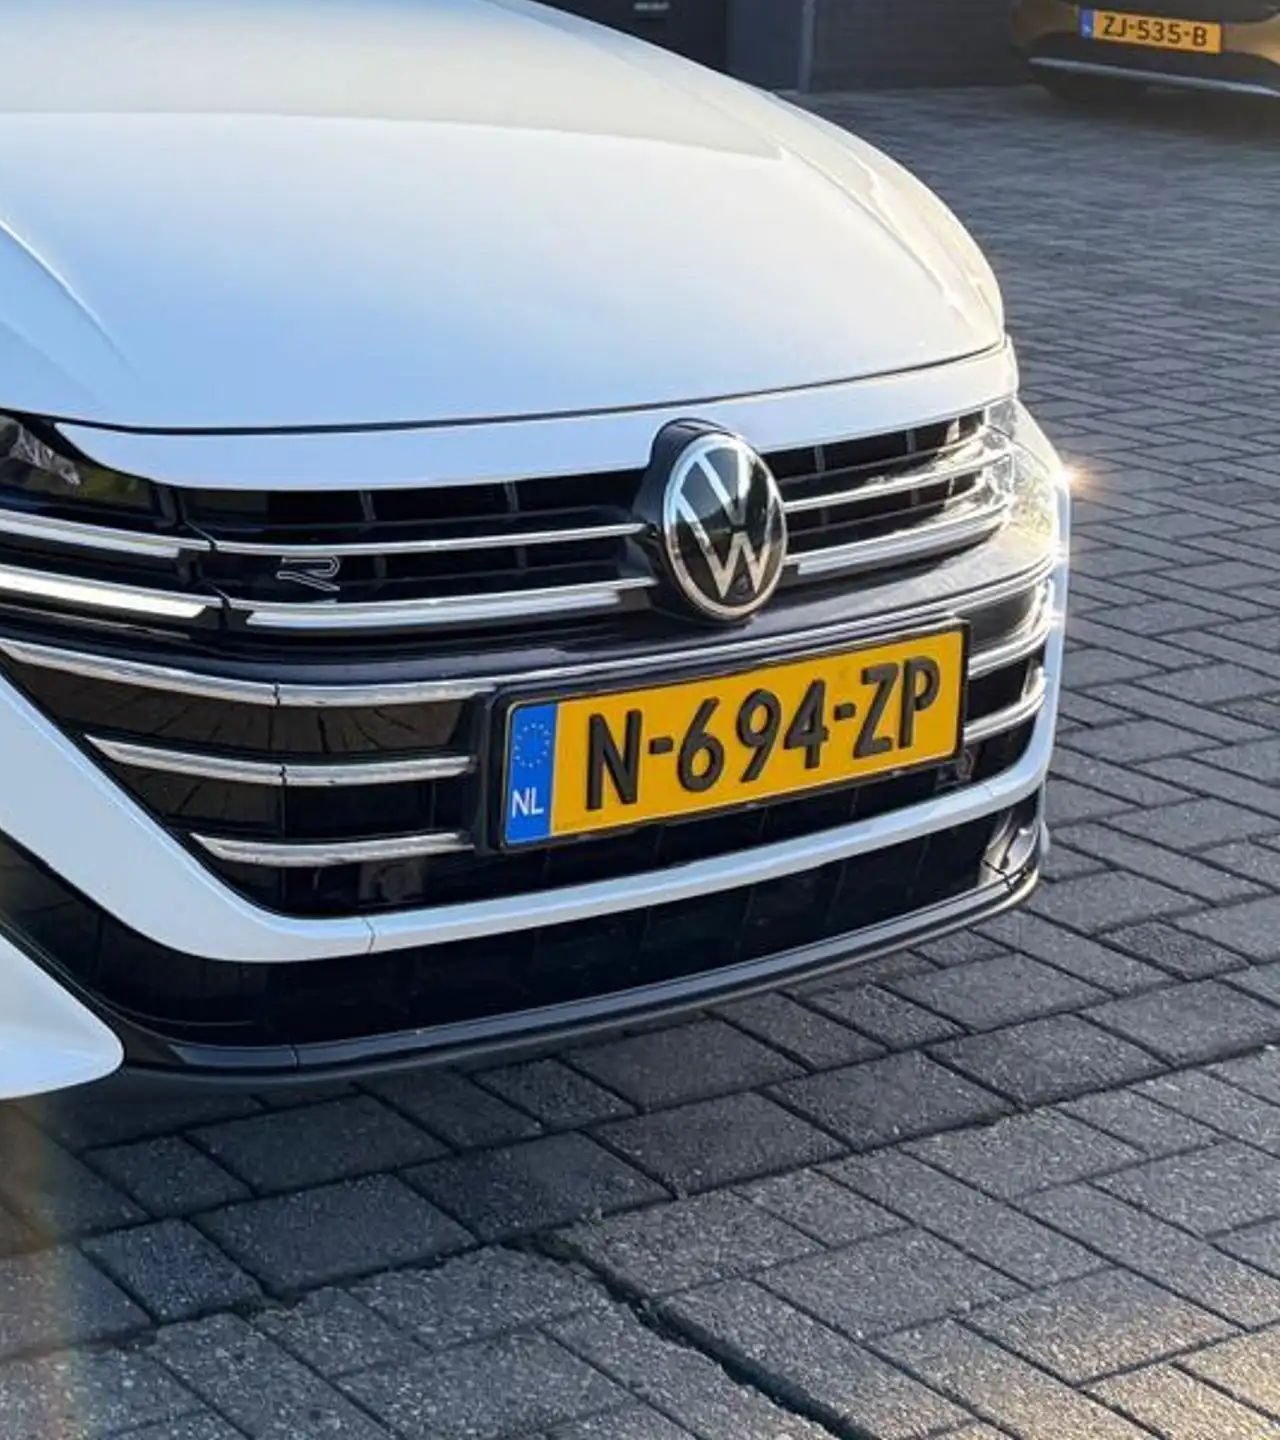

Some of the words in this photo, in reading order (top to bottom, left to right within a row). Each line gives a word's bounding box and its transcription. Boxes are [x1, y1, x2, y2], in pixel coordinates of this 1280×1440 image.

[1103, 14, 1208, 48] ZJ-535-B
[585, 655, 941, 812] N-694-ZP
[511, 786, 545, 818] NL
